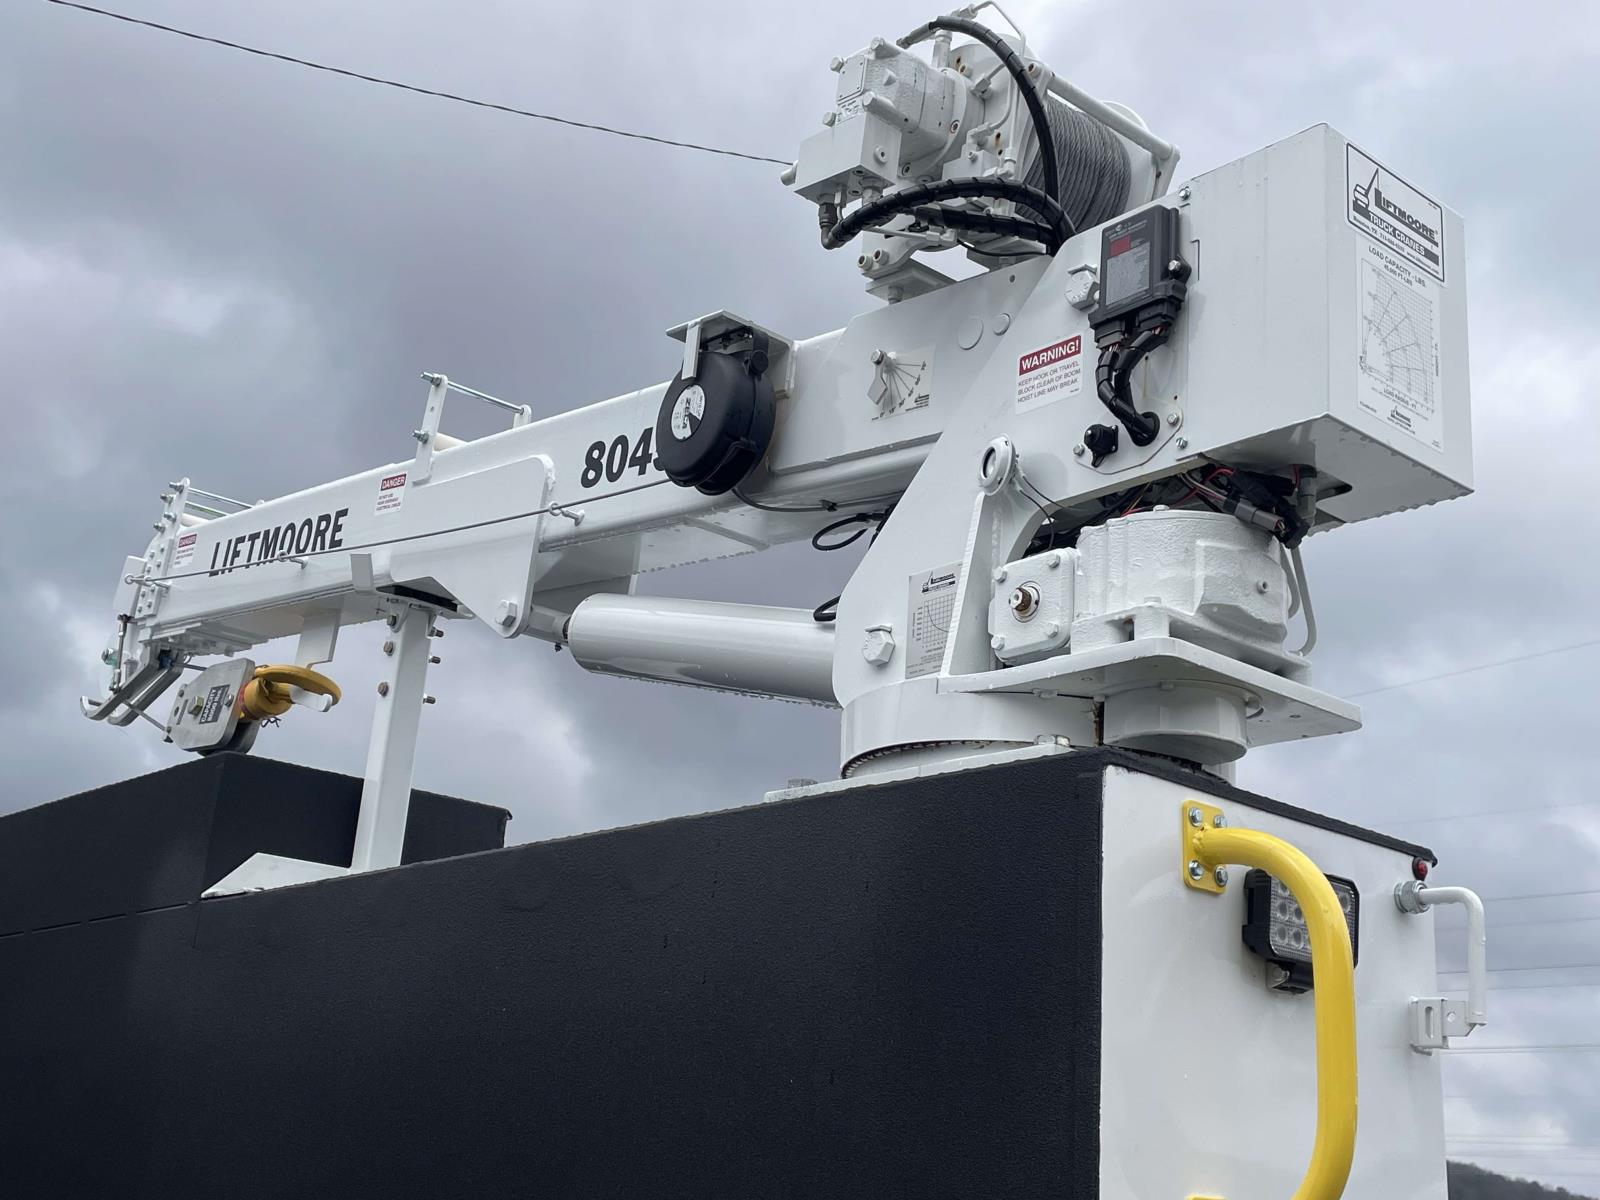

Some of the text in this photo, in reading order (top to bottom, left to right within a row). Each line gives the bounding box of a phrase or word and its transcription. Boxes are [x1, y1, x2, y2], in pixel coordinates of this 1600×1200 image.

[1369, 213, 1394, 236] TRUCK
[1395, 230, 1425, 256] CRANES
[1368, 245, 1384, 260] LOAD
[1385, 255, 1411, 277] CAPACITY
[1022, 340, 1079, 371] WARNING!
[1017, 368, 1080, 396] BLOCK CLEAR OF BOOM
[1018, 377, 1033, 387] KEEP
[1033, 372, 1049, 382] HOOK
[1059, 360, 1079, 371] TRAVEL
[1017, 393, 1033, 404] HOIST
[1034, 388, 1046, 398] LINE
[1047, 384, 1059, 393] MAY
[581, 427, 663, 488] 804
[382, 476, 405, 489] DANGER
[208, 508, 349, 577] LIFTMOORE
[201, 689, 217, 722] CAPACITY
